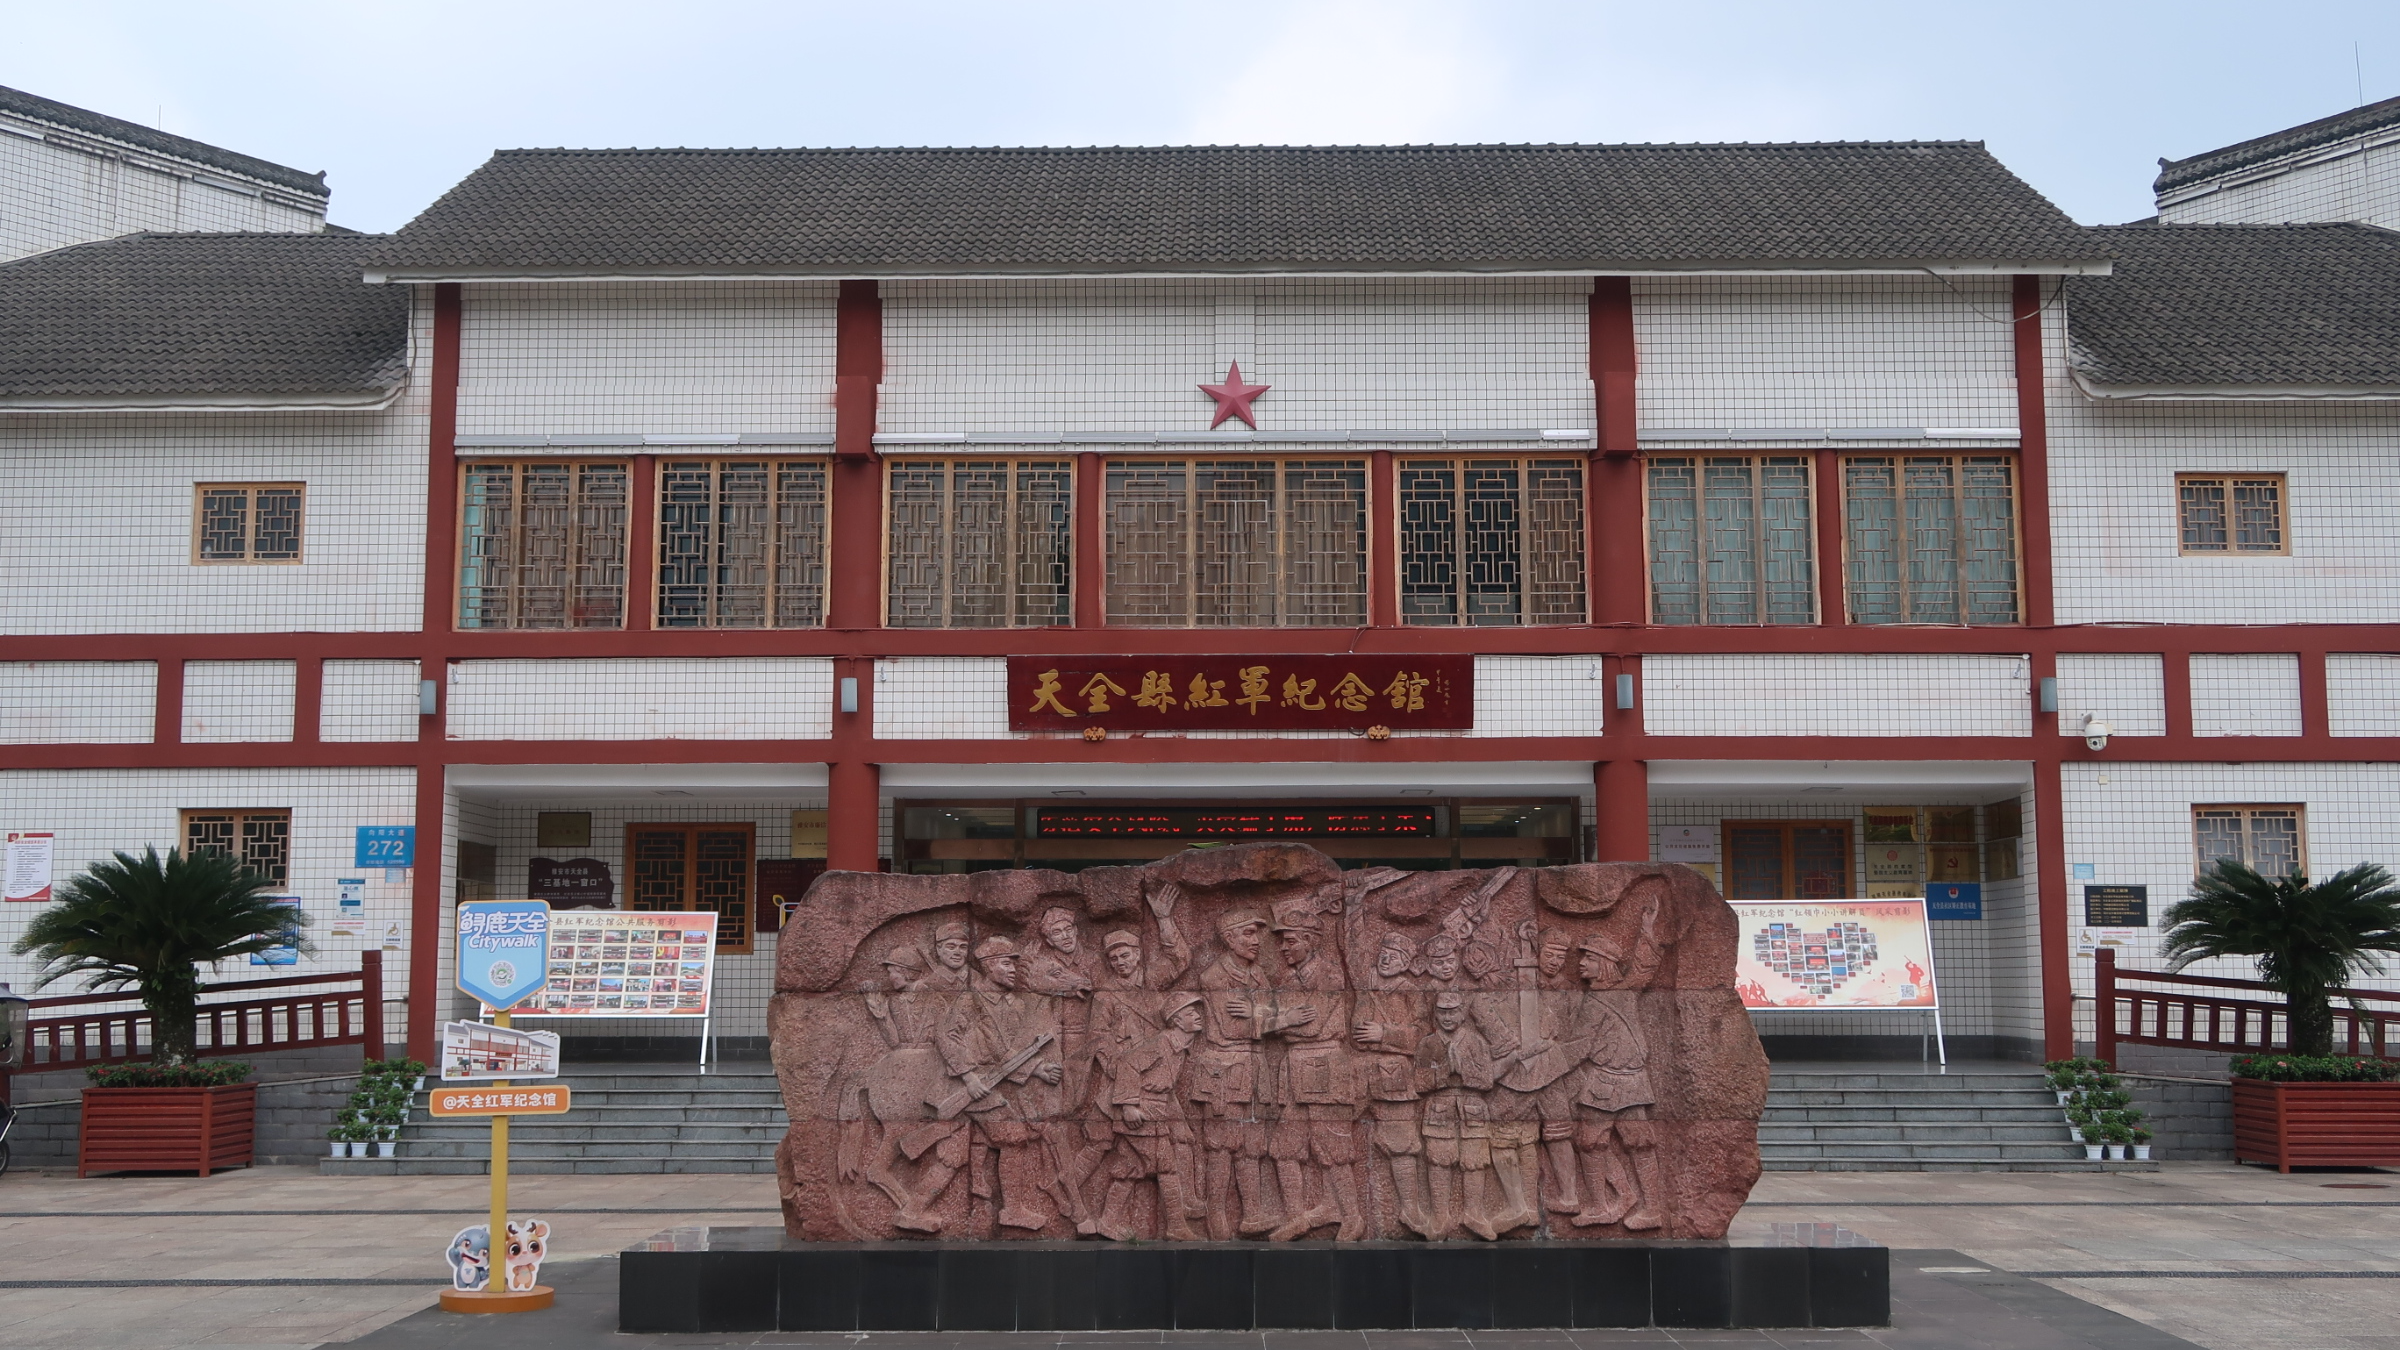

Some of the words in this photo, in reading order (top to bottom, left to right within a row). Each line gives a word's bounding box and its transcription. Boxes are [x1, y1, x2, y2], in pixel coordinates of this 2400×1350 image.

[367, 840, 404, 856] 272
[459, 911, 548, 934] 鲟鹿天全
[549, 916, 677, 927] 县红军纪念馆公共服务剪影
[469, 934, 538, 953] Citywalk
[443, 1093, 557, 1110] @天全红军纪念馆
